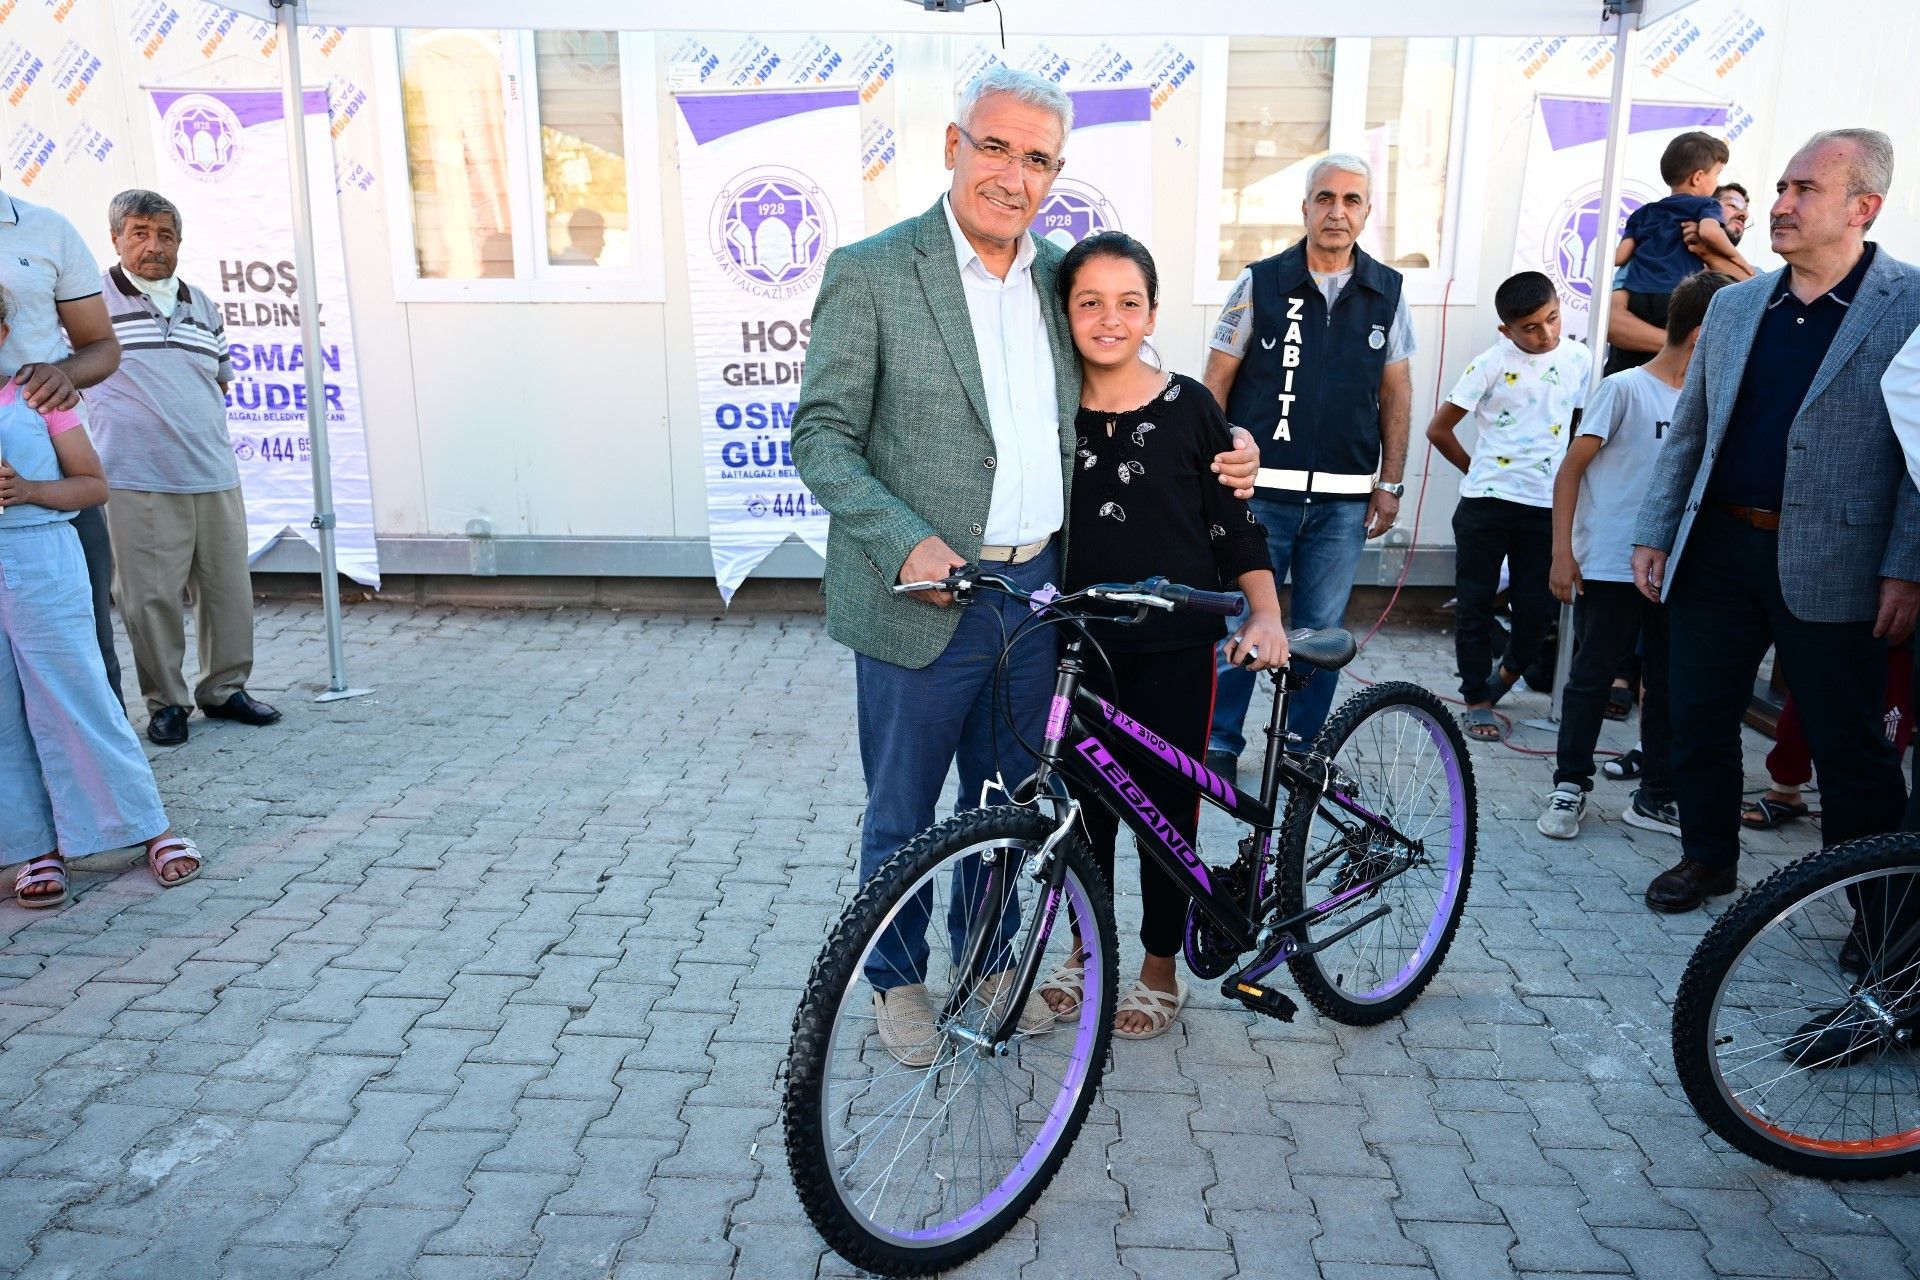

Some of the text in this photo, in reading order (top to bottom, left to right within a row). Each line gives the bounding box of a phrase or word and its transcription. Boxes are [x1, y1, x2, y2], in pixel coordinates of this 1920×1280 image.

[135, 2, 167, 43] PANEL
[143, 9, 179, 60] MEKPAN
[1645, 18, 1690, 62] PANEL
[1710, 18, 1755, 62] PANEL
[0, 50, 32, 91] PANEL
[57, 49, 90, 90] PANEL
[861, 44, 893, 86] PANE
[1651, 26, 1701, 78] MEKPAN
[1715, 26, 1765, 78] MEKPAN
[8, 57, 44, 107] MEKPAN
[66, 56, 102, 106] MEKPAN
[862, 58, 894, 103] EKPAN
[13, 132, 45, 171] PANEL
[20, 139, 56, 187] MEKPAN
[862, 128, 894, 168] PANE
[863, 142, 896, 182] EKPA
[758, 203, 785, 215] 1928
[1045, 214, 1072, 227] 1928
[219, 260, 298, 298] HOŞ
[1544, 264, 1589, 313] BATTALGA
[229, 344, 340, 371] SMAN
[1272, 297, 1304, 441] ZABITA
[261, 437, 295, 461] 444
[772, 493, 806, 517] 444
[1136, 725, 1167, 752] 3100
[1082, 742, 1200, 868] LEGANO
